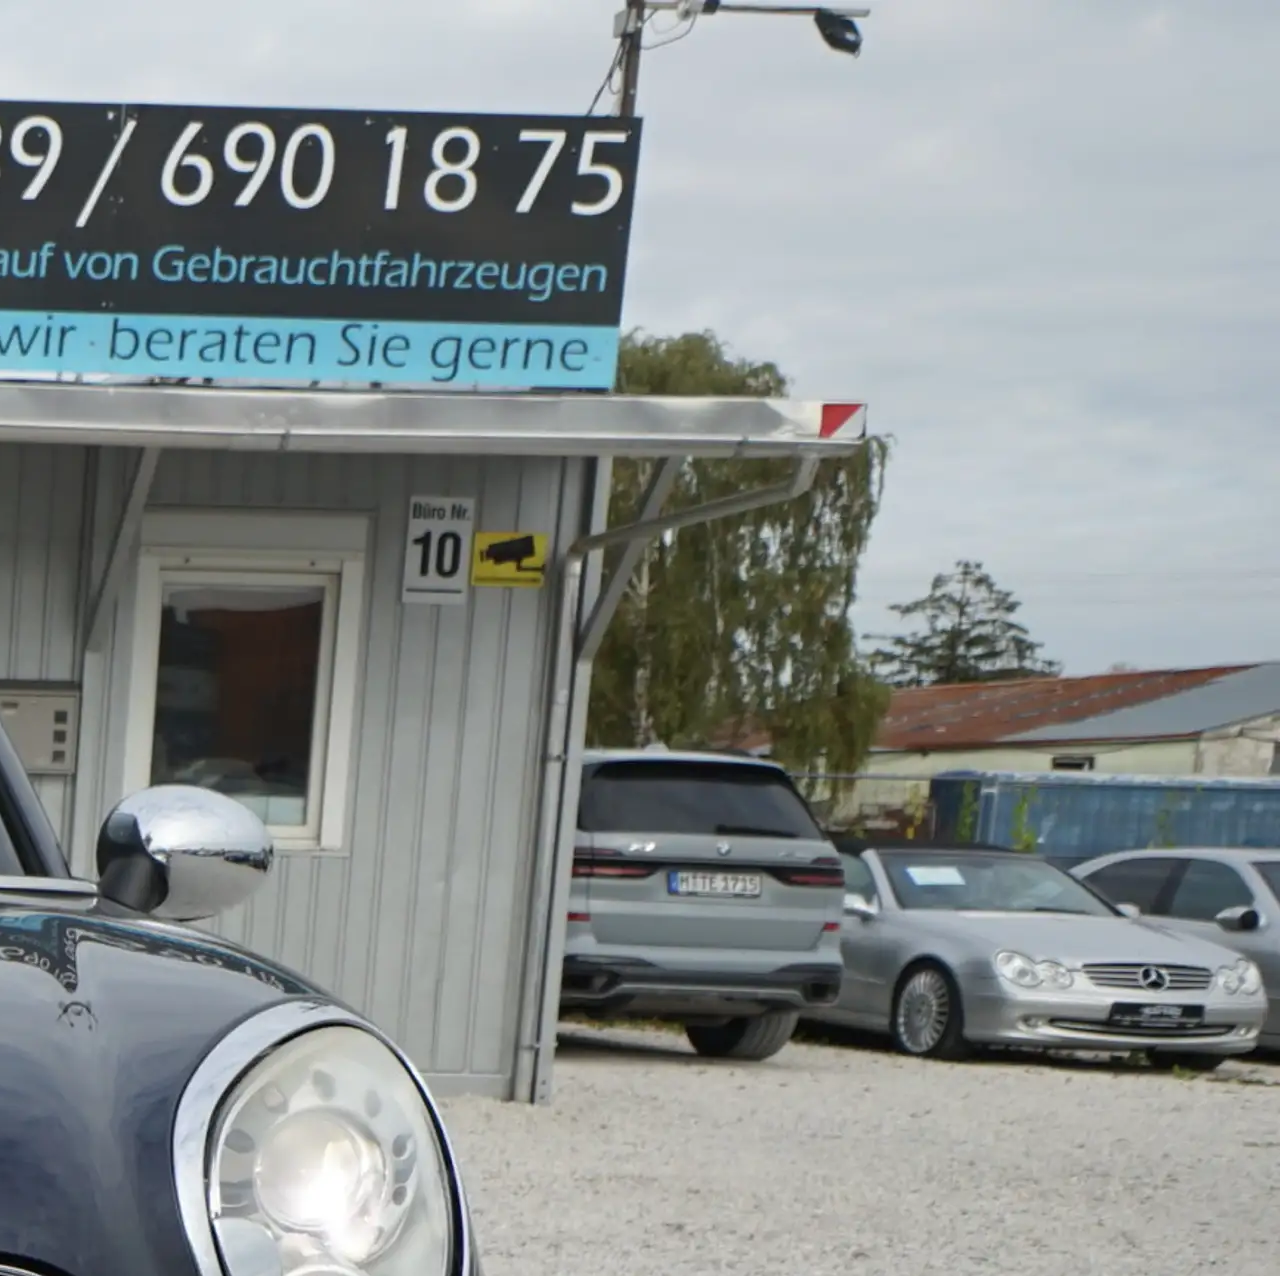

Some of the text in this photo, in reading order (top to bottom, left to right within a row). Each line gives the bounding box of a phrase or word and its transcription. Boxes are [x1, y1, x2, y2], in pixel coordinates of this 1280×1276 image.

[383, 126, 480, 213] 18
[515, 129, 628, 216] 75
[65, 251, 139, 281] von
[152, 245, 608, 301] Gebrauchtfahrzeugen
[109, 317, 316, 366] beraten
[337, 323, 411, 368] Sie
[430, 335, 587, 382] gerne
[412, 502, 470, 520] Büro Nr.
[413, 529, 461, 578] 10
